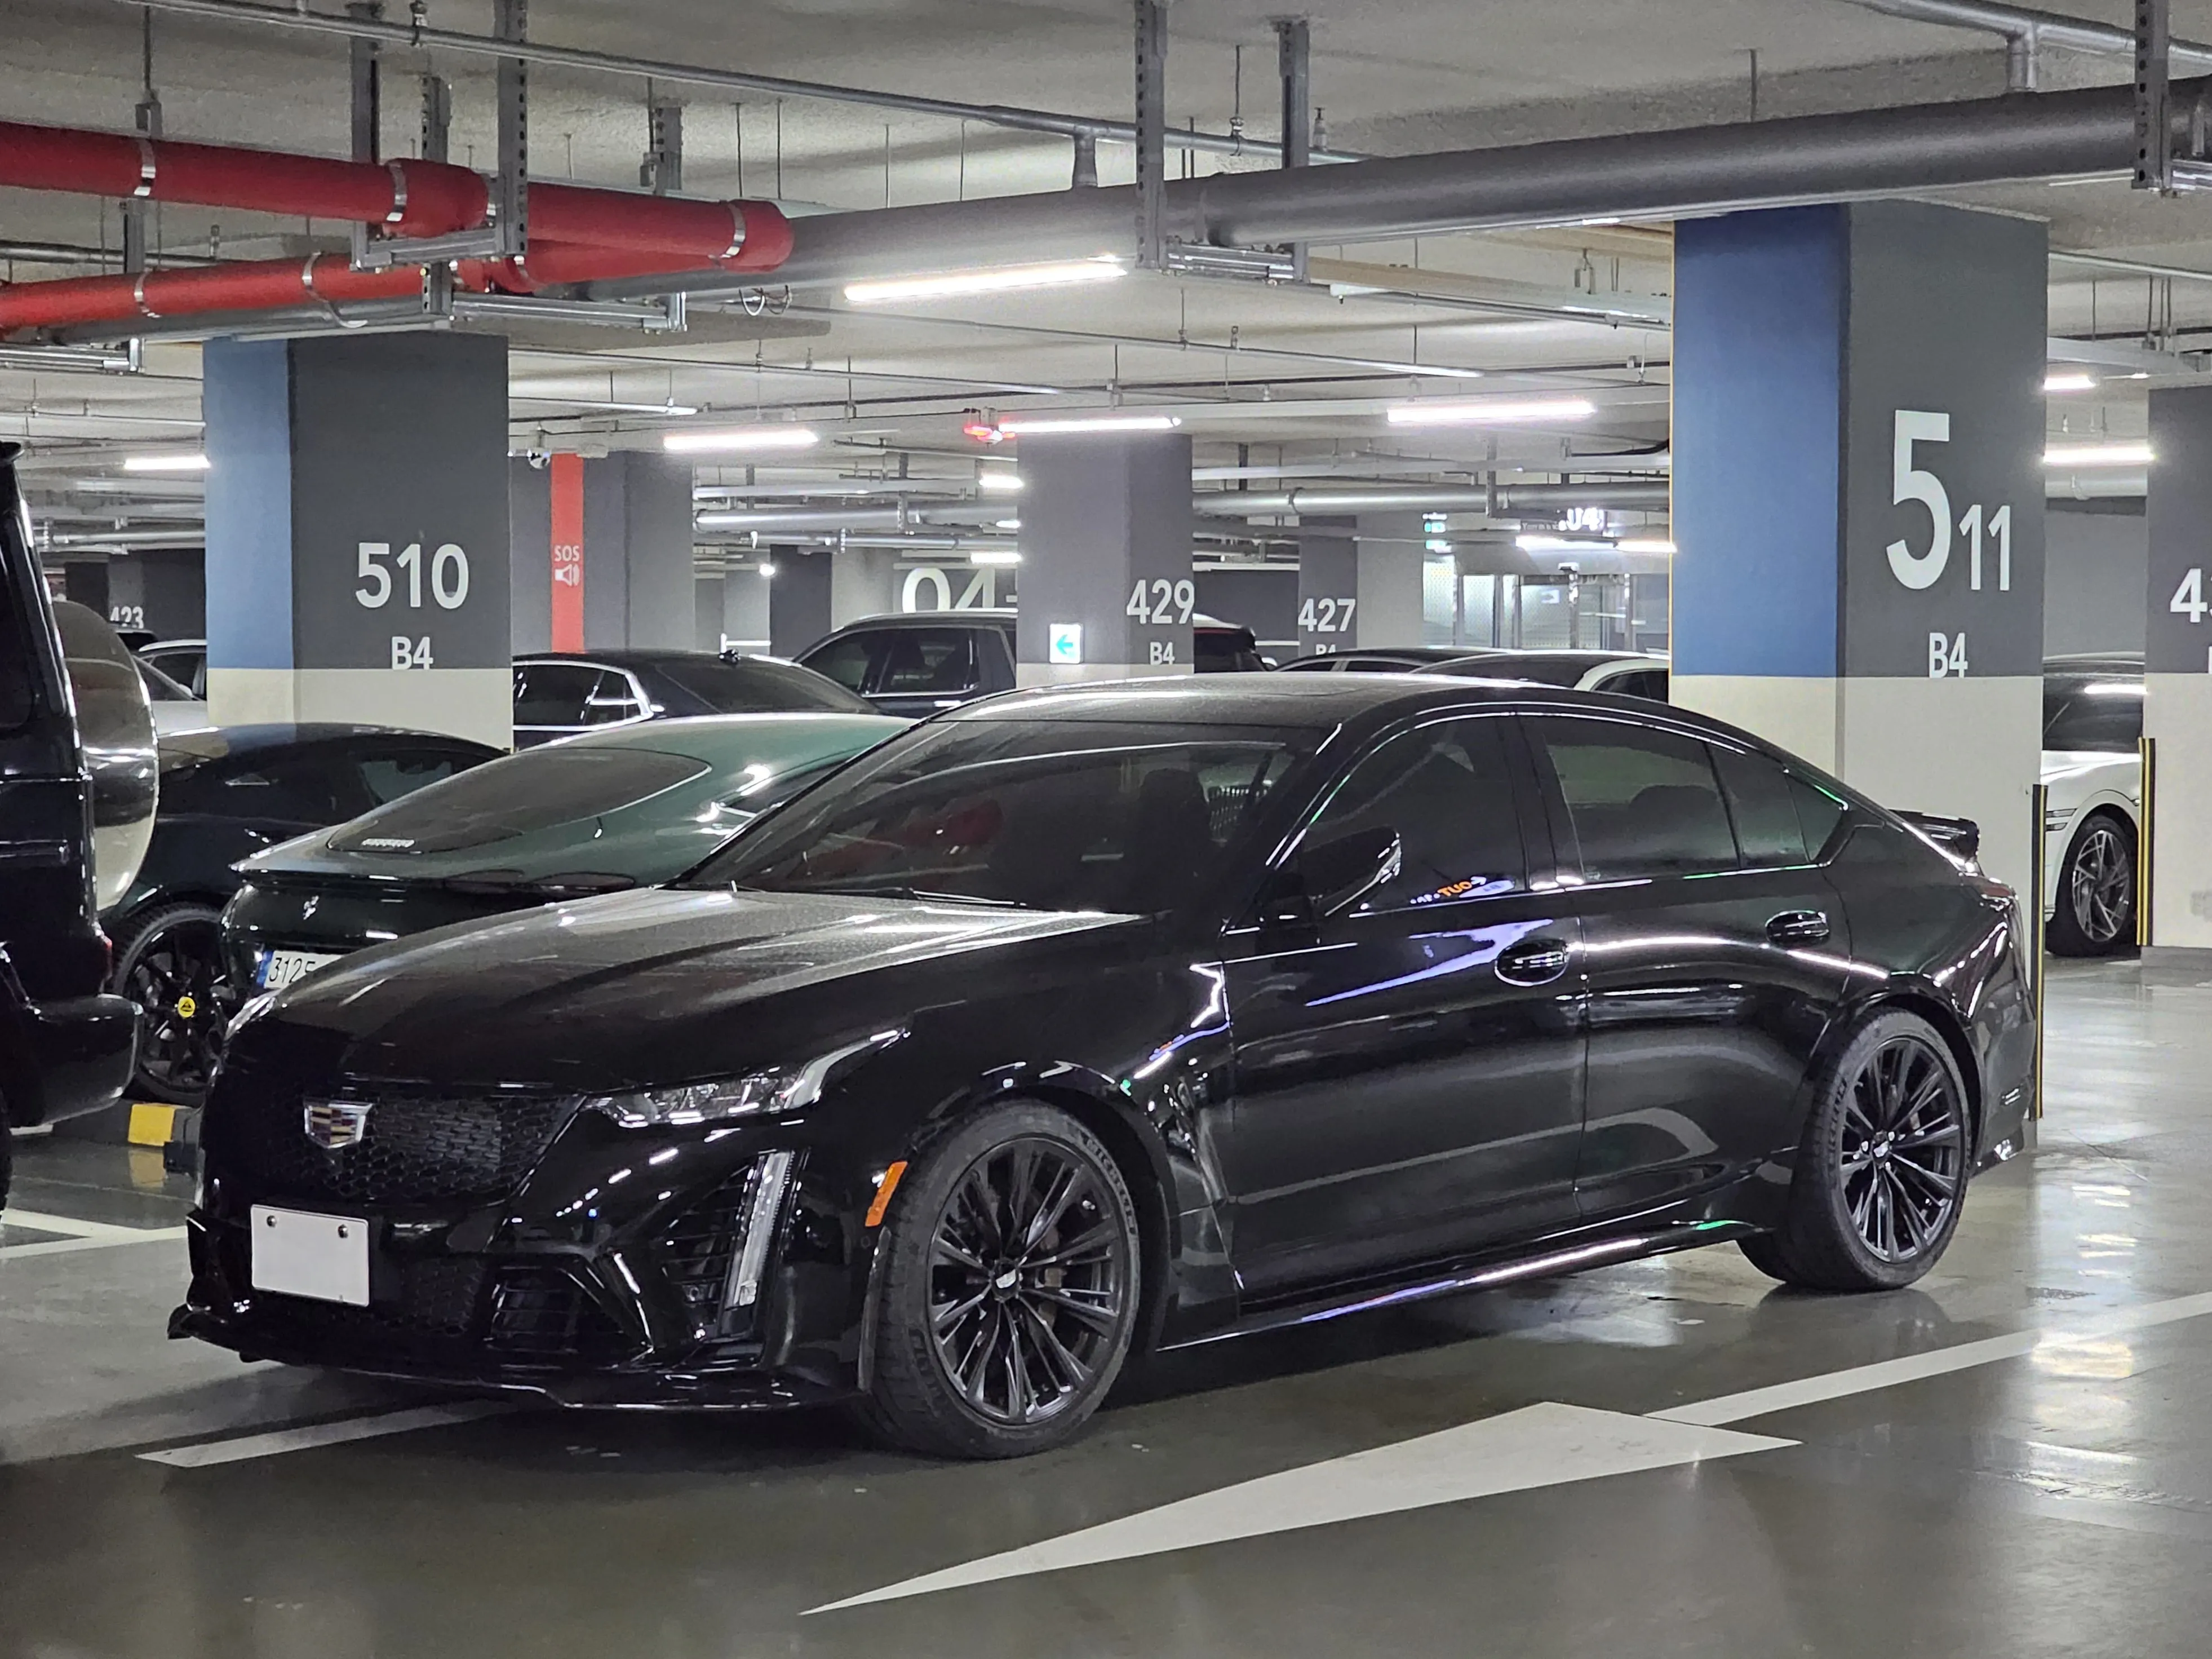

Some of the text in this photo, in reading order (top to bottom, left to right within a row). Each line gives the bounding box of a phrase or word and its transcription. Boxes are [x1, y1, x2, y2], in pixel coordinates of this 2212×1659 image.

[1886, 409, 2011, 591] 511
[554, 545, 580, 562] SOS
[355, 542, 469, 609] 510
[1127, 579, 1195, 624] 429
[1297, 598, 1356, 632] 427
[2170, 568, 2212, 623] 4
[110, 605, 144, 629] 423
[391, 636, 434, 670] B4
[1150, 642, 1175, 665] B4
[1929, 632, 1969, 679] B4
